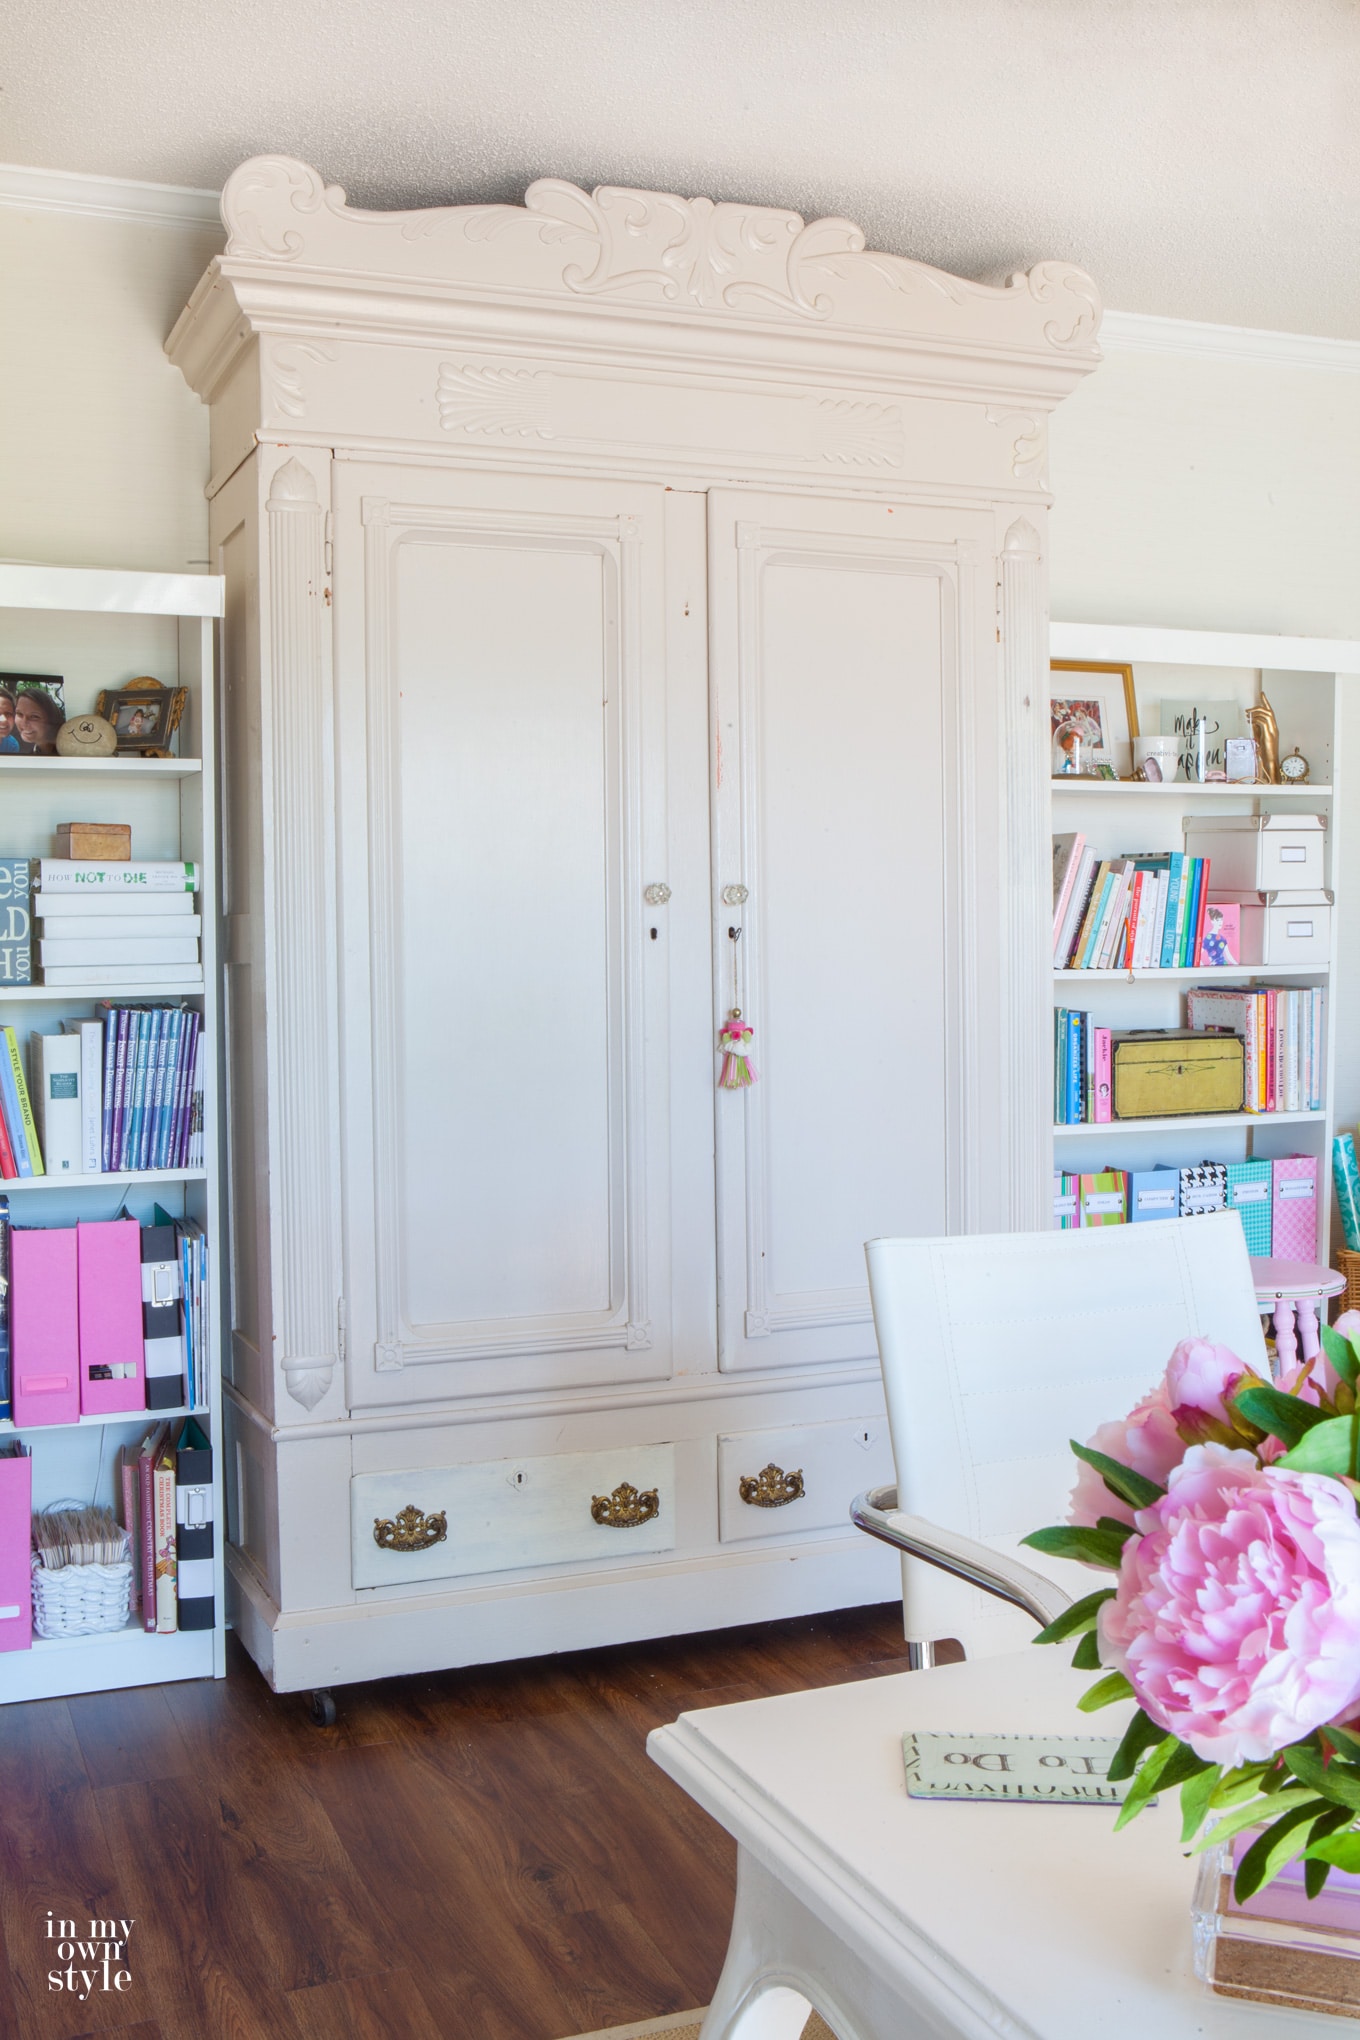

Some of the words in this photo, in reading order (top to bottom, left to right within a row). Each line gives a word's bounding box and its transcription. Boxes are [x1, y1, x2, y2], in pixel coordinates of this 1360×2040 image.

[13, 862, 29, 899] you
[75, 872, 106, 883] NOT
[123, 872, 147, 884] DIE
[1169, 877, 1180, 902] YOUNG
[1166, 903, 1178, 928] HOUSE
[1164, 929, 1175, 950] LOVE
[16, 945, 31, 982] you
[10, 1048, 21, 1072] STYLE
[106, 1041, 116, 1067] INSTANT
[117, 1040, 126, 1066] INSTANT
[127, 1040, 136, 1066] INSTANT
[138, 1040, 147, 1066] INSTANT
[148, 1040, 158, 1066] INSTANT
[159, 1039, 168, 1066] INSTANT
[168, 1039, 177, 1065] INSTANT
[15, 1073, 25, 1096] YOUR
[105, 1070, 115, 1109] DECORATING
[114, 1068, 125, 1108] DECORATING
[124, 1068, 134, 1108] DECORATING
[135, 1068, 145, 1108] DECORATING
[145, 1068, 156, 1108] DECORATING
[155, 1067, 167, 1107] DECORATING
[164, 1066, 175, 1106] DECORATING
[20, 1098, 32, 1126] BRAND
[88, 1117, 97, 1134] Janet
[89, 1136, 97, 1155] Luhrs
